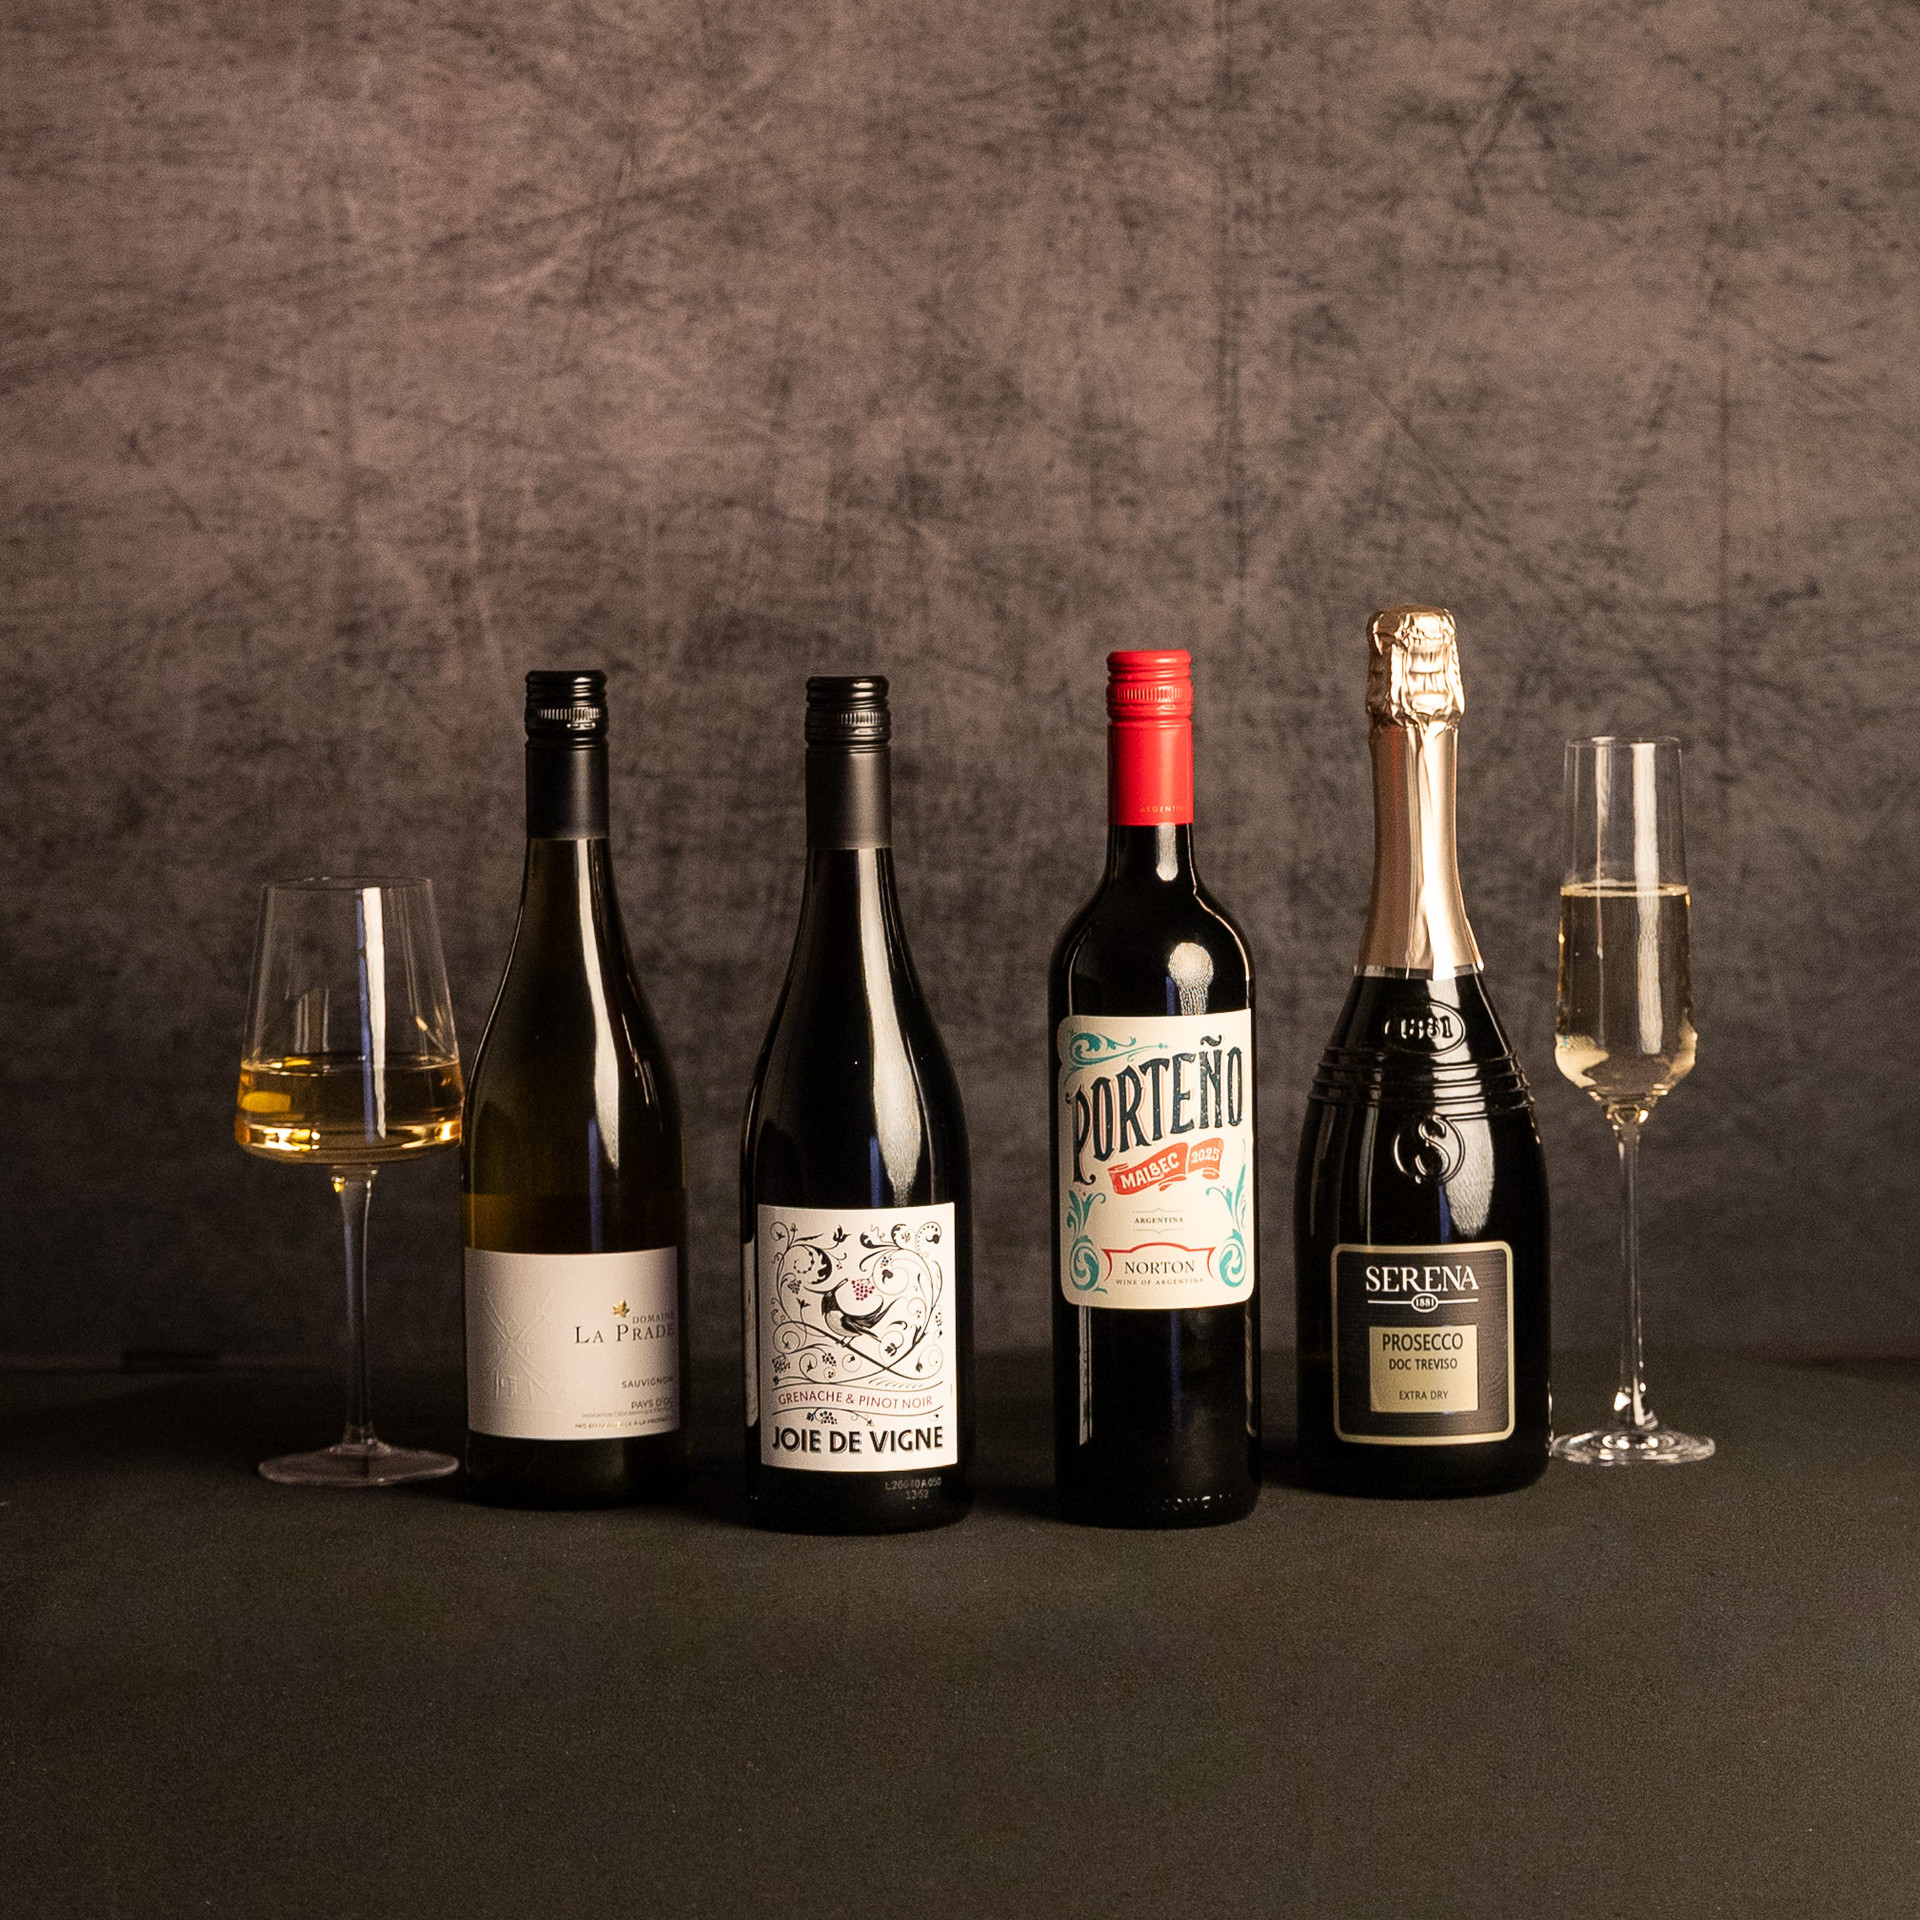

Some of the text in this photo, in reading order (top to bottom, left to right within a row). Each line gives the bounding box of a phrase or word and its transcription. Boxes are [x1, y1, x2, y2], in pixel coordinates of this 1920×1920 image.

[1065, 1034, 1243, 1186] PORTEÑO
[1120, 1147, 1220, 1190] MALBEC 2025
[1134, 1217, 1184, 1225] ARGENTINA
[1124, 1260, 1195, 1275] NORTON
[1155, 1278, 1203, 1286] ARGENTINA
[1365, 1265, 1480, 1293] SERENA
[1415, 1298, 1436, 1308] 1881
[1382, 1333, 1463, 1352] PROSECCO
[1389, 1358, 1458, 1371] DOC TREVISO
[778, 1390, 933, 1410] GRENACHE & PINOT NOIR
[1399, 1390, 1449, 1401] EXTRA DRY
[631, 1400, 653, 1410] PAYS
[772, 1426, 943, 1454] JOIE DE VIGNE
